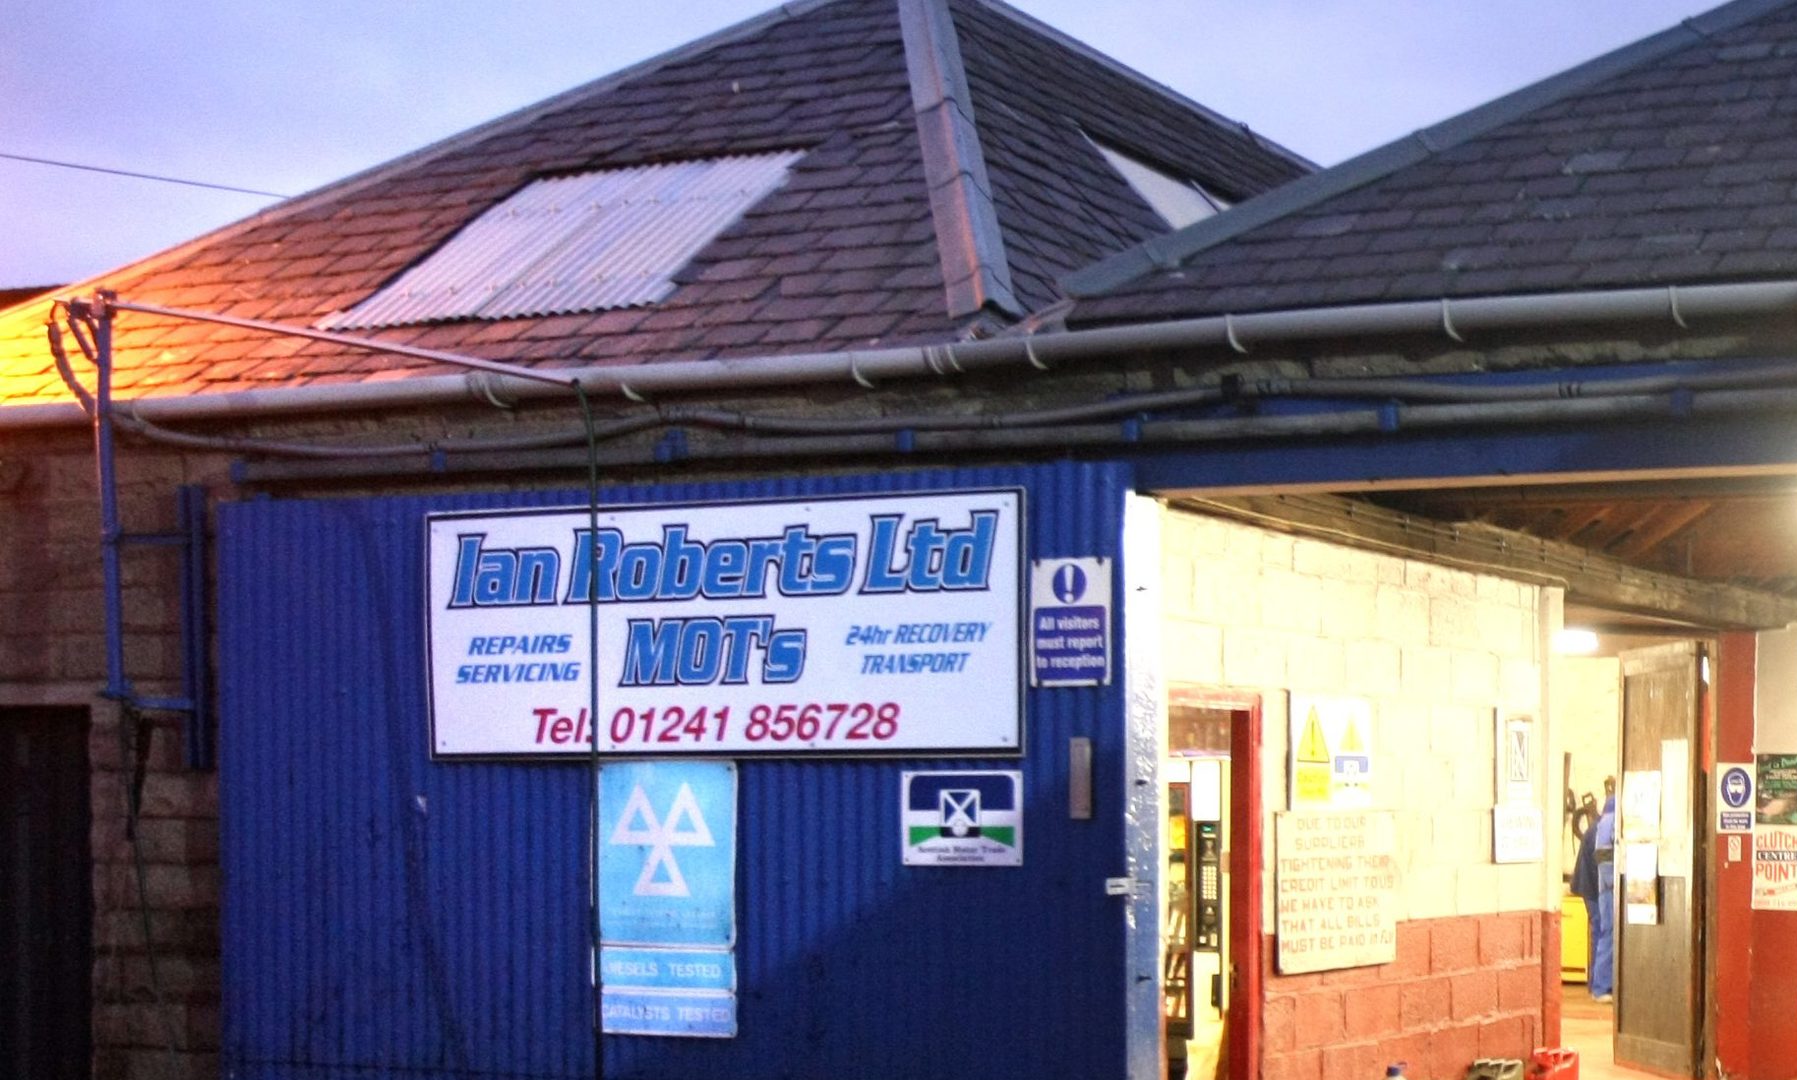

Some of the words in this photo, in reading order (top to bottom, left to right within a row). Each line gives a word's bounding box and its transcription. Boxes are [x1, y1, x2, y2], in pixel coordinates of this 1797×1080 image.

[447, 533, 560, 610] Ian
[562, 525, 859, 607] Roberts
[859, 509, 999, 597] Ltd
[1039, 616, 1056, 631] All
[1057, 615, 1100, 631] visitors
[844, 625, 892, 647] 24hr
[893, 621, 993, 646] RECOVERY
[1036, 636, 1065, 650] must
[1067, 635, 1104, 651] report
[467, 633, 573, 658] REPAIRS
[617, 614, 807, 688] MOT's
[859, 651, 971, 676] TRANSPORT
[1036, 655, 1048, 669] to
[1050, 654, 1106, 670] reception
[454, 661, 581, 685] SERVICING
[609, 706, 732, 744] 01241
[745, 702, 900, 742] 856728
[1296, 816, 1321, 831] DUE
[1326, 816, 1342, 830] TO
[1343, 815, 1367, 830] OUR
[1295, 835, 1365, 852] SUPPLIERS
[1280, 855, 1353, 873] TIGHTENING
[1757, 851, 1797, 861] CENTRE
[1755, 862, 1797, 883] POINT
[1280, 877, 1326, 893] CREDIT
[1331, 876, 1360, 891] LIMIT
[1363, 875, 1378, 889] TO
[1379, 874, 1395, 889] US
[1279, 899, 1297, 914] WE
[1302, 896, 1335, 912] HAVE
[1338, 896, 1354, 910] TO
[1281, 918, 1315, 934] THAT
[1319, 916, 1343, 931] ALL
[1346, 913, 1381, 929] BILLS
[1281, 937, 1315, 955] MUST
[1319, 936, 1335, 950] BE
[1339, 932, 1366, 949] PAID
[669, 963, 722, 980] TESTED
[602, 1003, 671, 1021] CATALYSTS
[676, 1006, 730, 1024] TESTED
